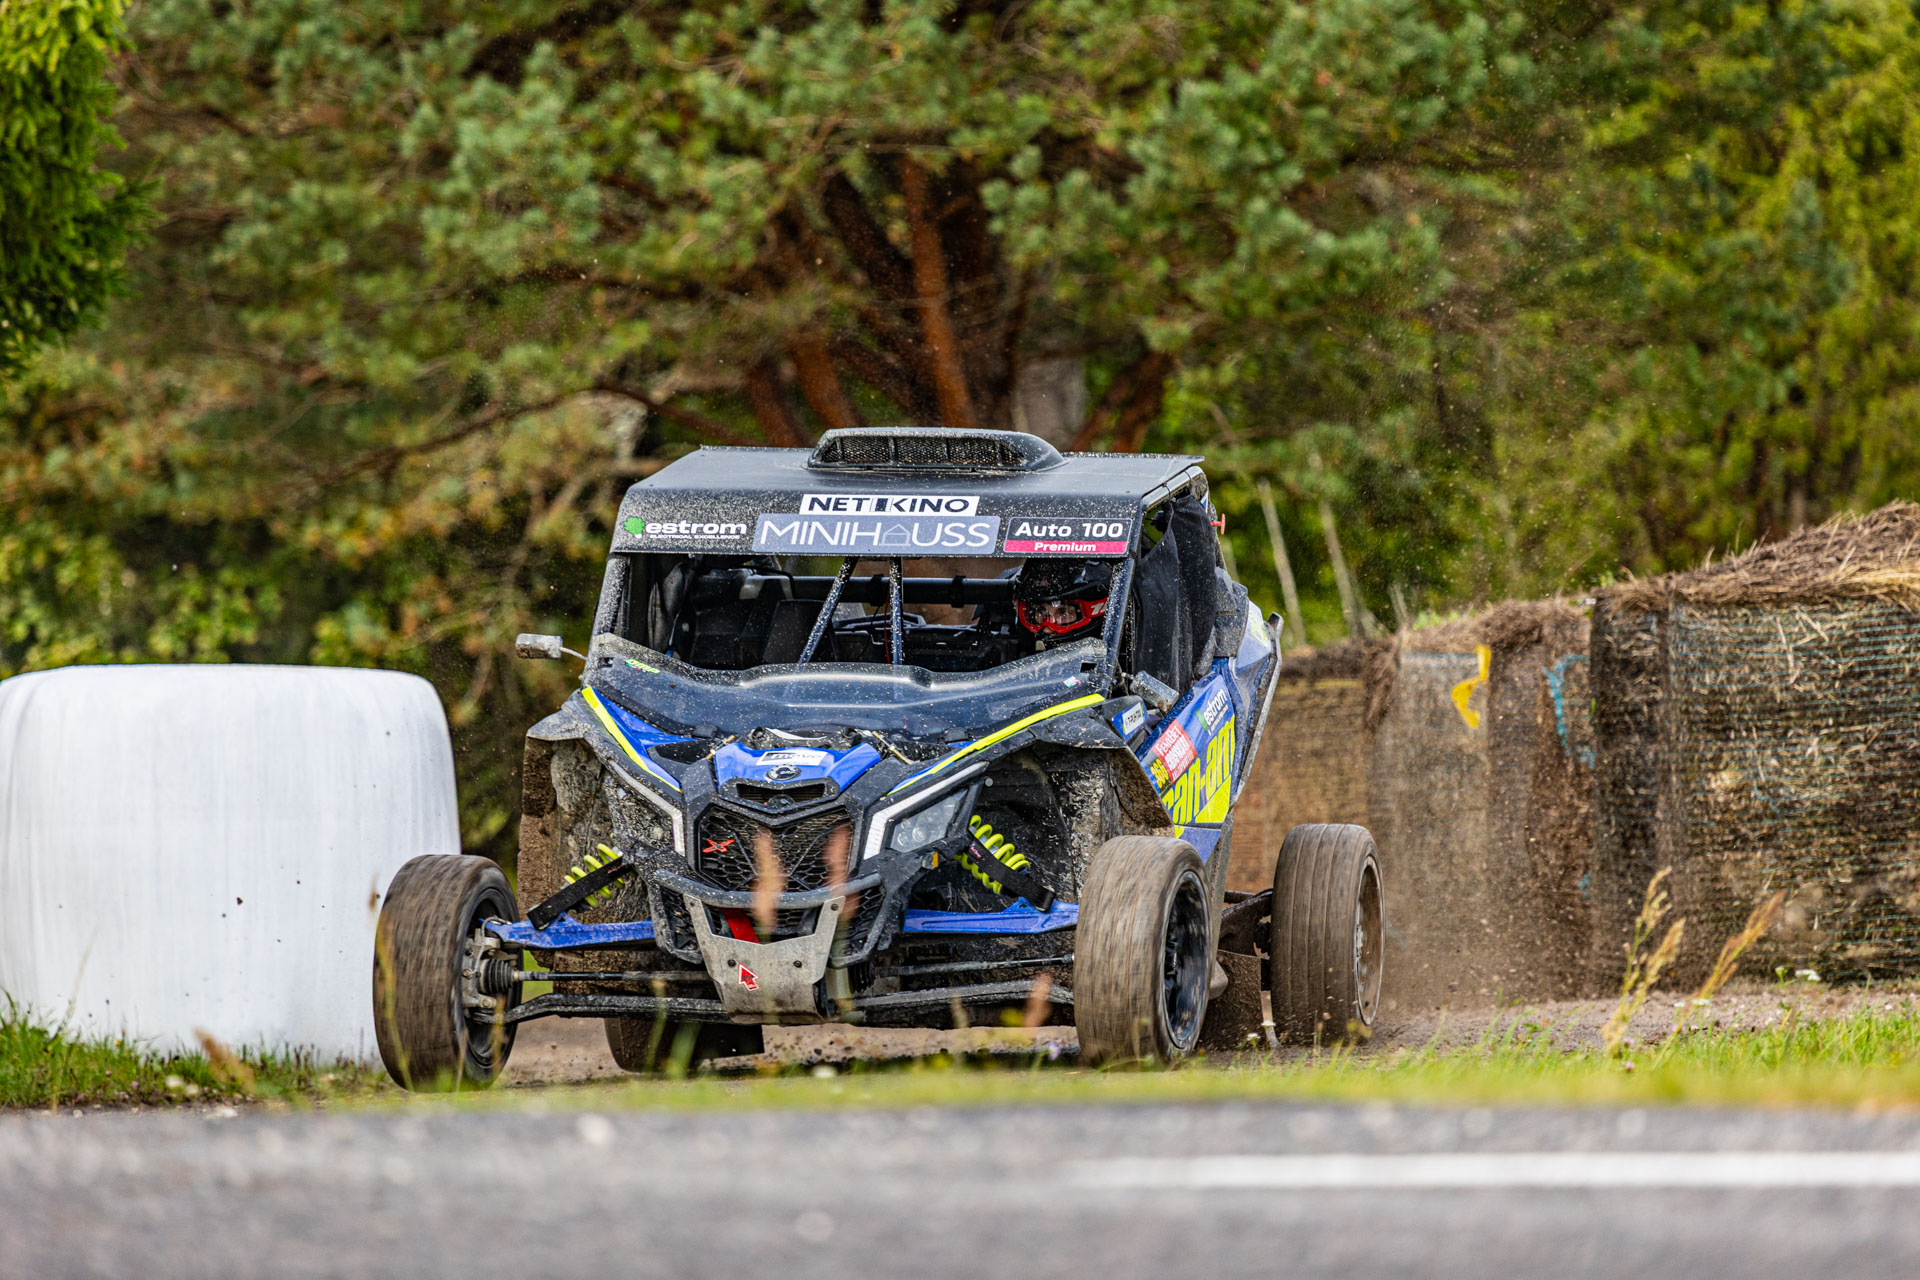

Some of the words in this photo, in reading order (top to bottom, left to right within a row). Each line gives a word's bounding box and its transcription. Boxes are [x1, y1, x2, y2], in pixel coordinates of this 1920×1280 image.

[645, 520, 748, 535] estrom
[1014, 521, 1073, 537] Auto
[1082, 522, 1124, 538] 100
[1034, 541, 1097, 552] Premium
